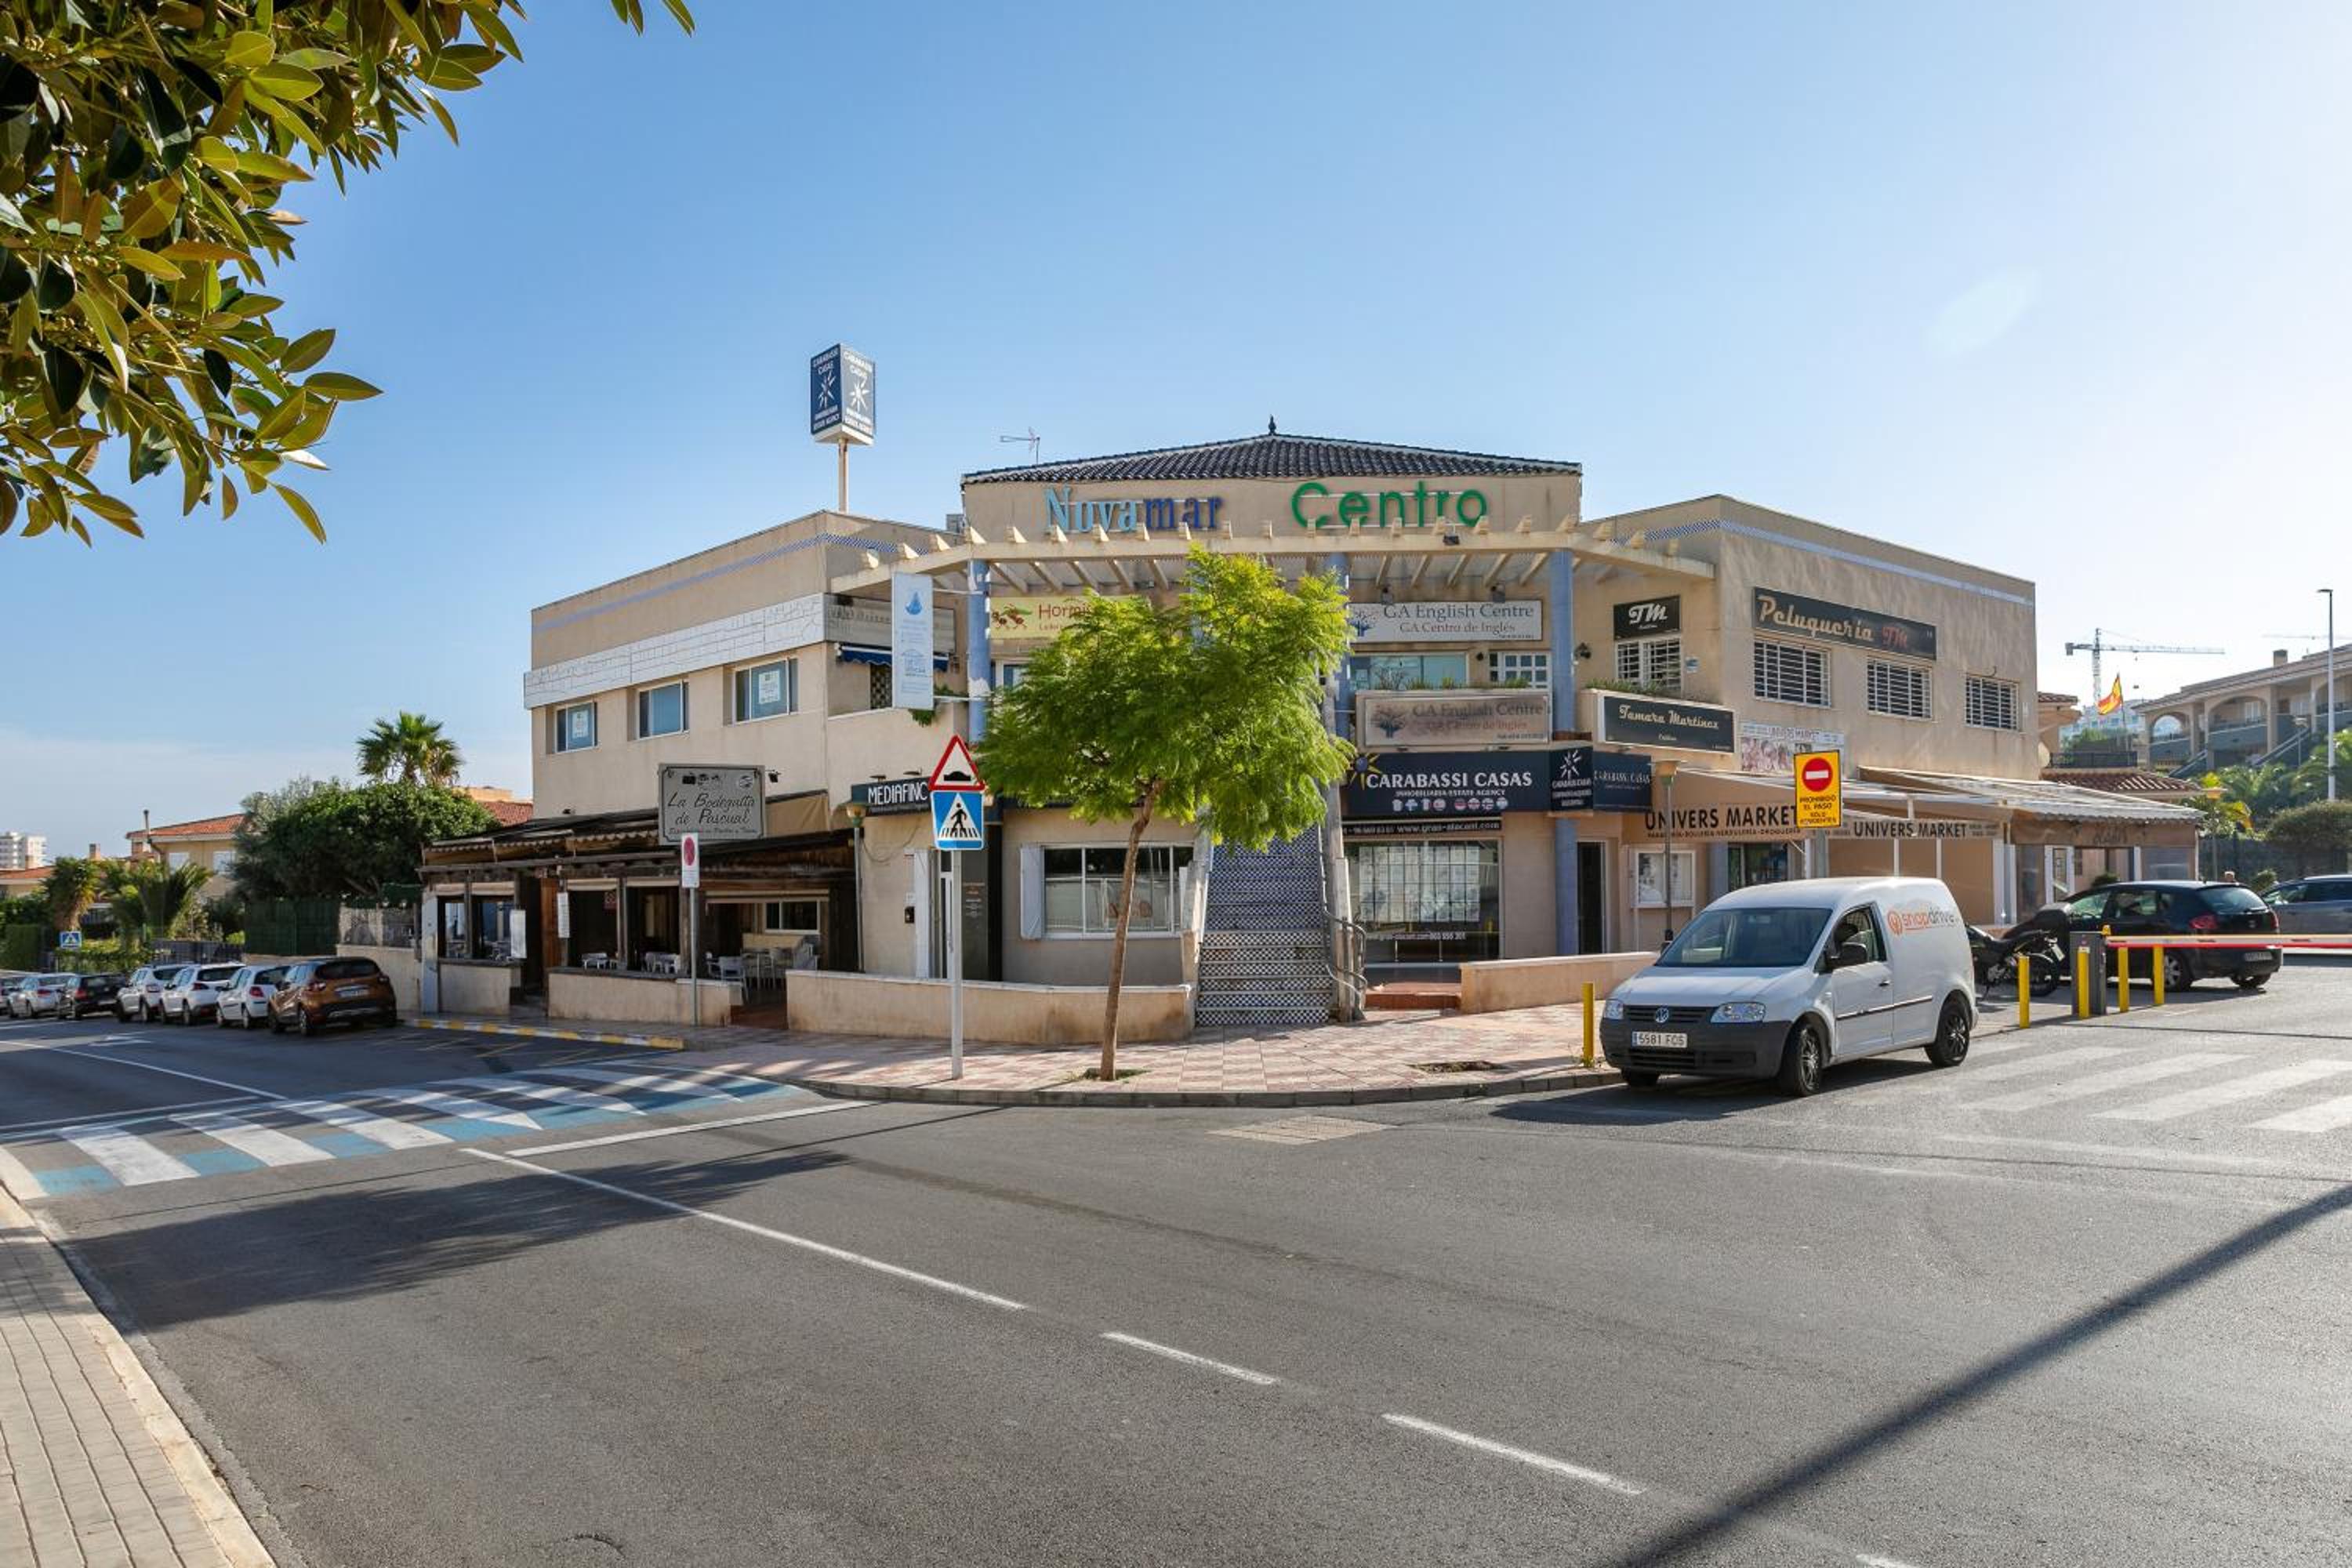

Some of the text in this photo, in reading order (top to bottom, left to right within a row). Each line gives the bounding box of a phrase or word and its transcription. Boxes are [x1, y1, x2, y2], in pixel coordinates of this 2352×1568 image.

[1044, 481, 1487, 533] Novamar Centro
[1384, 604, 1534, 621] GA English Centre
[1628, 603, 1668, 625] TM
[1422, 622, 1461, 633] Centro
[1465, 622, 1479, 633] de
[1441, 703, 1493, 720] English
[1496, 702, 1544, 716] Centre
[1618, 705, 1666, 724] Tamara
[1367, 771, 1533, 789] CARABASSI CASAS
[668, 791, 687, 808] La
[675, 808, 750, 825] de Pascual
[1645, 805, 1798, 830] UNIVERS MARKET
[1853, 821, 1915, 837] UNIVERS
[1918, 822, 1967, 837] MARKET
